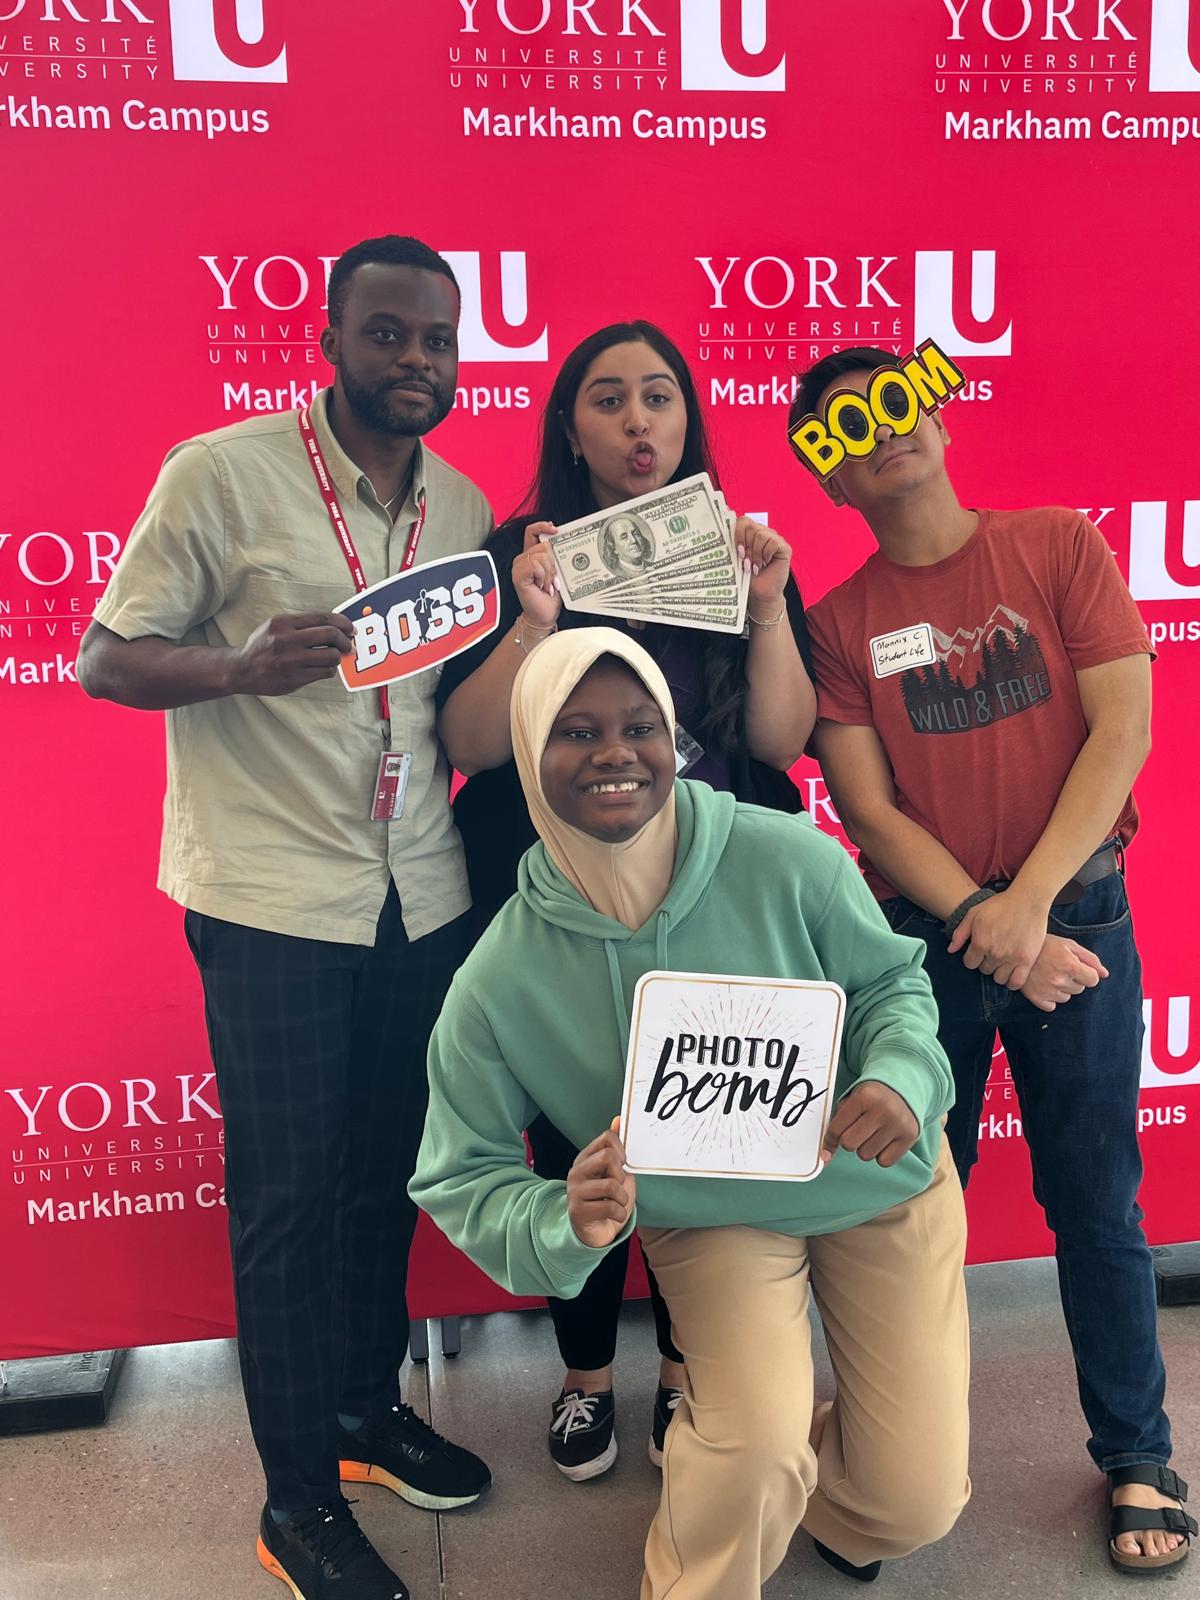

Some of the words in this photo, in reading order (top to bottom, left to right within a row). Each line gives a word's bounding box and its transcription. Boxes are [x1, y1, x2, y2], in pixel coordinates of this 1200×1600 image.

[458, 0, 666, 36] YORK
[943, 0, 1138, 41] YORK
[449, 47, 667, 66] UNIVERSITÉ
[935, 51, 1138, 69] UNIVERSITÉ
[450, 73, 668, 90] UNIVERSITY
[935, 78, 1138, 93] UNIVERSITY
[0, 95, 111, 129] kham
[122, 99, 270, 139] Campus
[462, 106, 621, 138] Markham
[632, 108, 767, 146] Campus
[944, 110, 1091, 140] Markham
[694, 255, 901, 310] YORK
[698, 317, 902, 337] UNIVERSITÉ
[699, 344, 902, 360] UNIVERSY
[788, 341, 966, 480] BOOM
[352, 573, 486, 673] BOSS
[878, 650, 907, 666] Student
[909, 643, 925, 657] Life
[910, 697, 970, 731] WILD
[974, 690, 993, 723] &
[995, 671, 1049, 714] FREE
[676, 1033, 786, 1070] PHOTO
[644, 1037, 829, 1128] bomb
[4, 1072, 224, 1137] YORK
[27, 1189, 185, 1225] Markham
